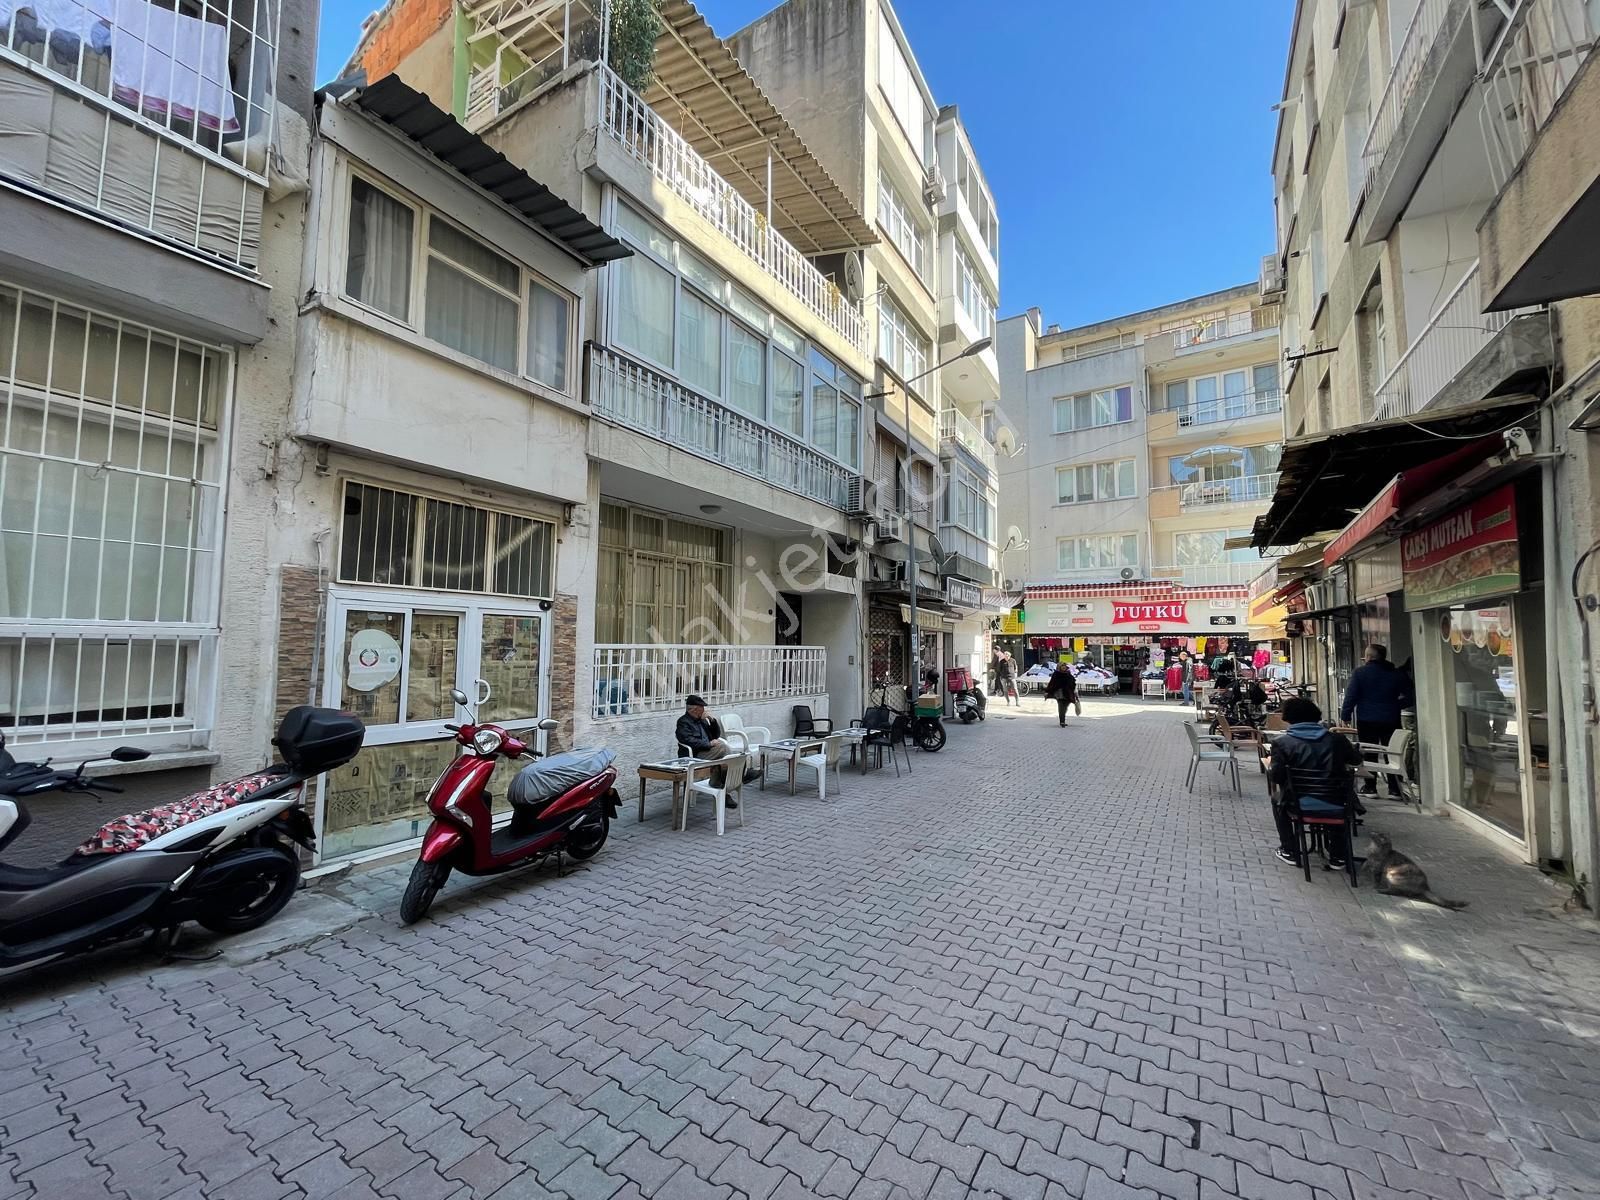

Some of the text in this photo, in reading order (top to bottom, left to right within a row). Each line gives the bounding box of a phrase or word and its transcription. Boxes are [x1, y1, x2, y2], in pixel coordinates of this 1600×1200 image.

[1404, 531, 1429, 568] ÇARŞI
[1431, 508, 1474, 551] MUTFAK
[1115, 605, 1183, 619] TUTKU
